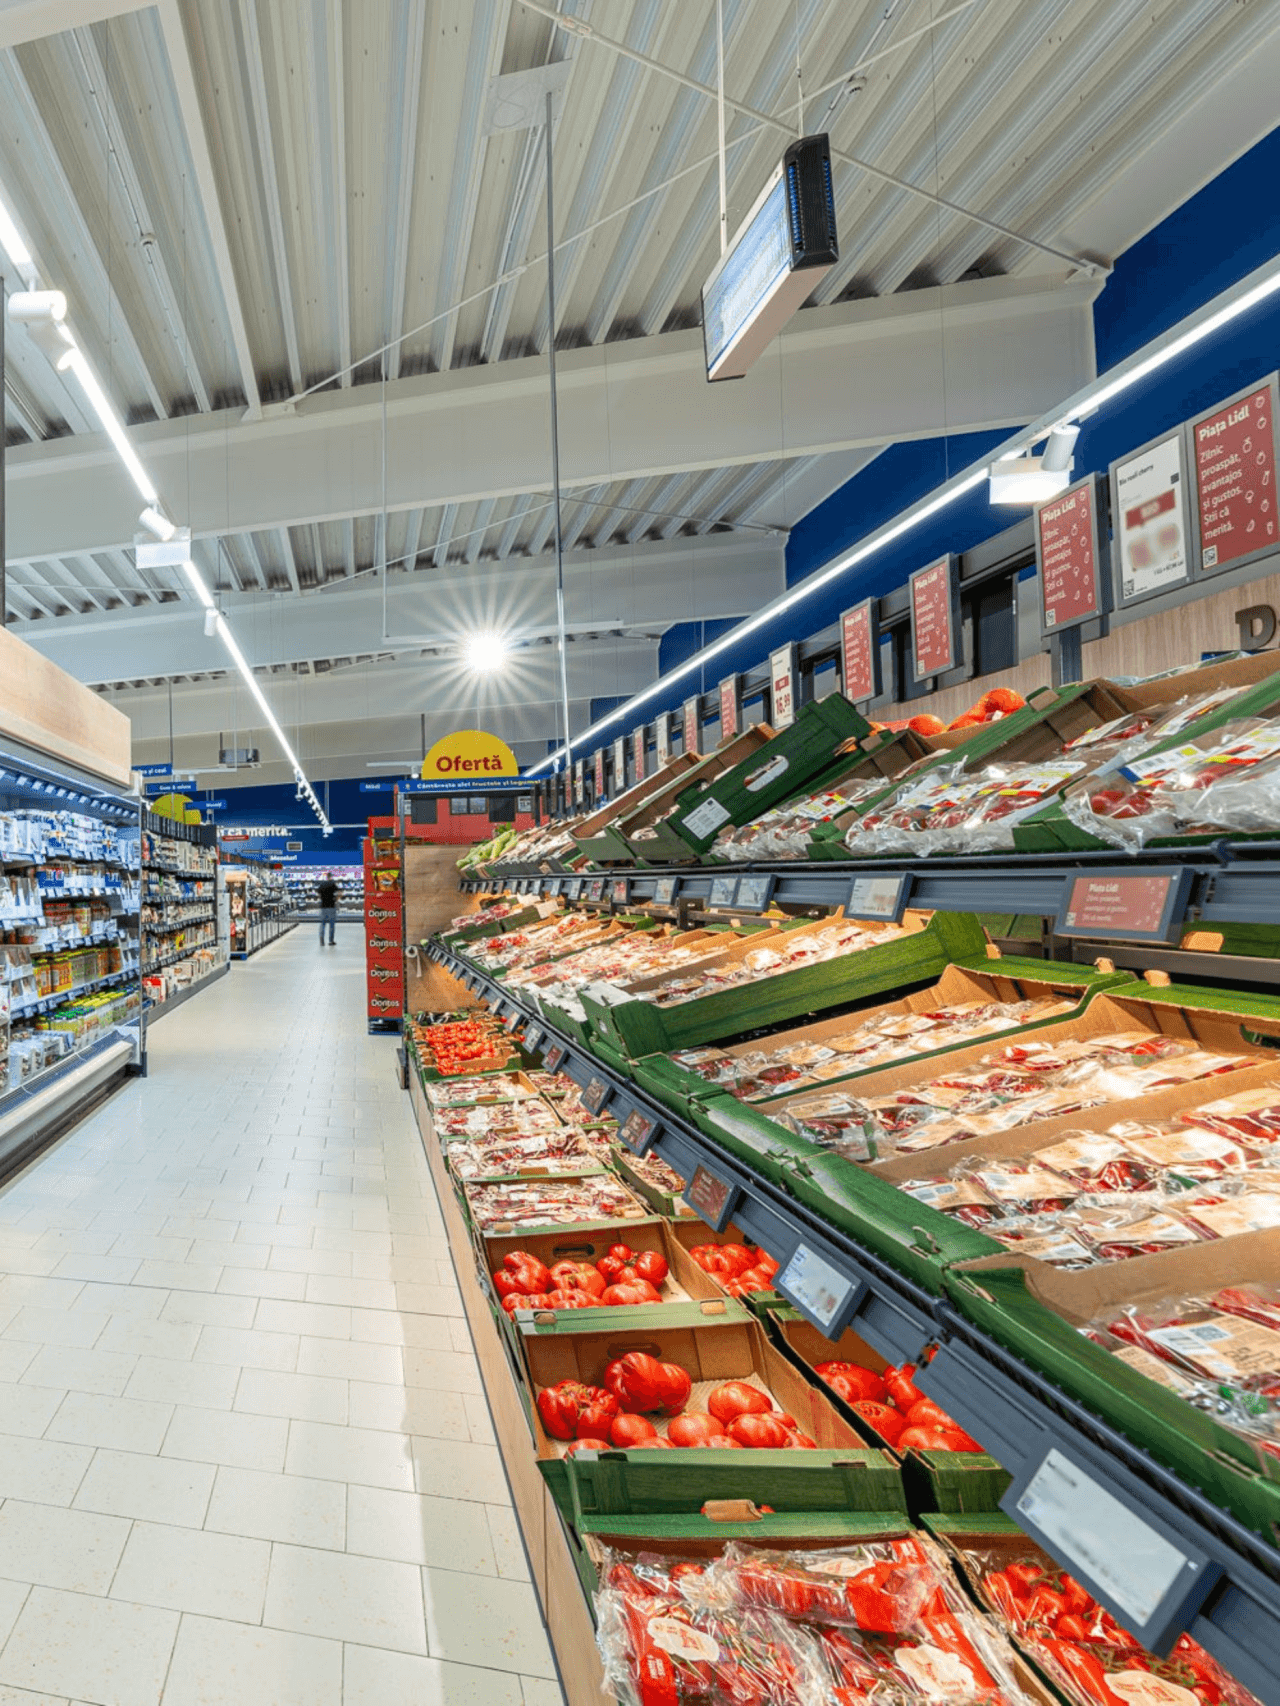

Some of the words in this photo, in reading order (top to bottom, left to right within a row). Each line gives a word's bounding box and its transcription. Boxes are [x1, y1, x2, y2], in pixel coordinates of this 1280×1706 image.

[1199, 421, 1226, 442] Piața
[1228, 405, 1250, 426] Lidl
[1200, 444, 1224, 464] Zilnic
[1201, 453, 1241, 480] proaspăt,
[1202, 469, 1242, 494] avantajos
[1061, 498, 1076, 513] Lidl
[1212, 487, 1243, 508] gustos.
[1235, 604, 1280, 650] D
[436, 754, 503, 773] Ofertă
[369, 939, 398, 947] Doritos
[370, 969, 399, 977] Doritos
[371, 999, 400, 1007] Doritos
